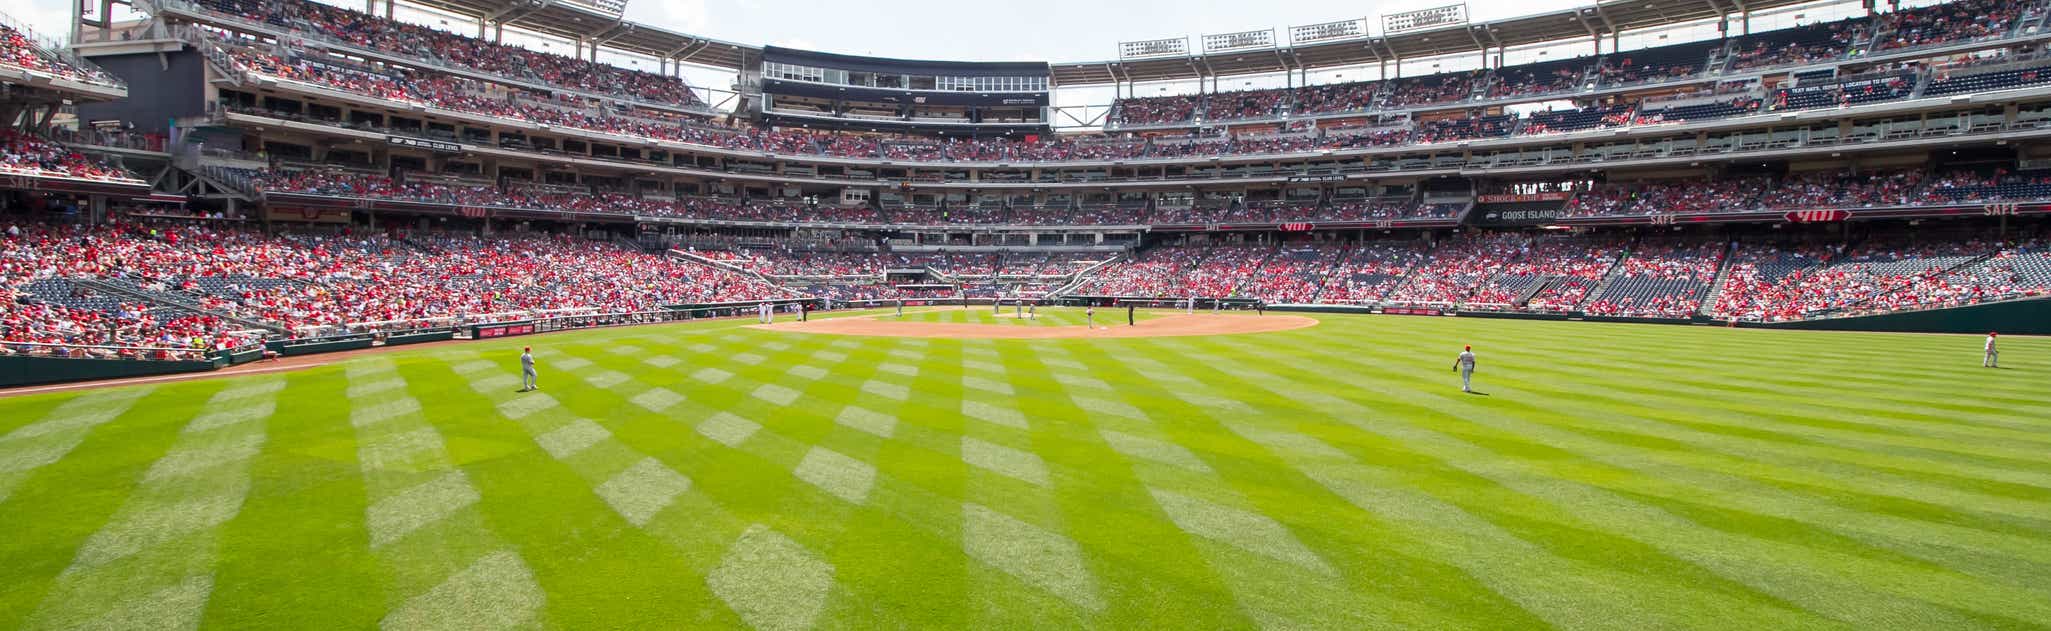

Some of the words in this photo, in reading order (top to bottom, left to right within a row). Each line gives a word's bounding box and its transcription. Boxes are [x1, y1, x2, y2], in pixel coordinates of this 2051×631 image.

[8, 176, 40, 190] SAFE
[1502, 210, 1527, 220] GOOSE
[1528, 210, 1555, 219] ISLAND
[1984, 203, 2019, 216] SAFE
[1650, 214, 1677, 225] SAFE
